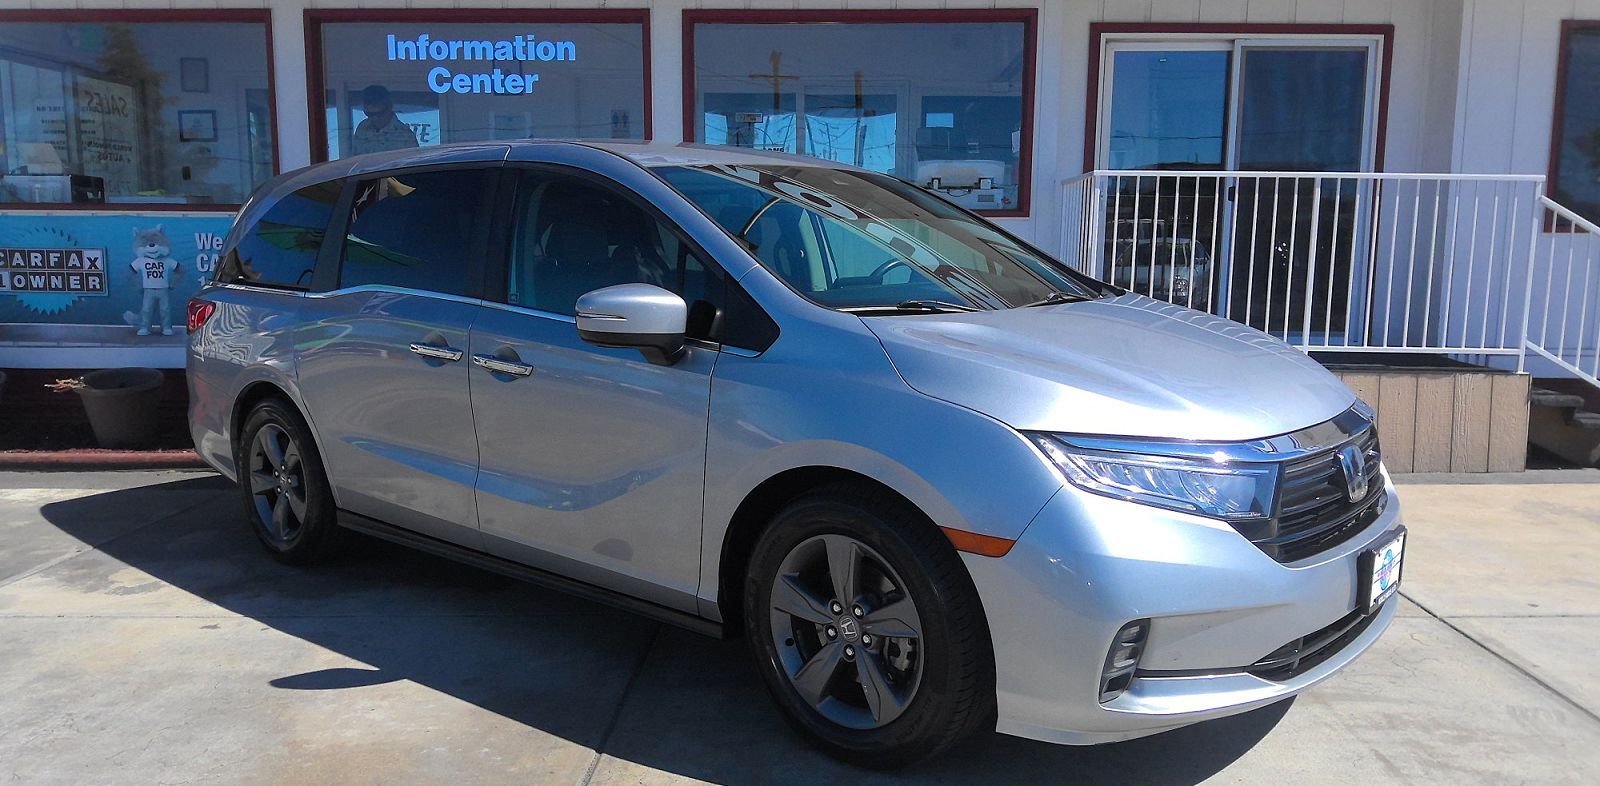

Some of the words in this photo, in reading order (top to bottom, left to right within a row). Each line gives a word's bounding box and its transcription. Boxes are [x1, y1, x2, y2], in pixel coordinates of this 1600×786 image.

[387, 34, 576, 61] Information
[427, 66, 539, 94] Center
[194, 232, 223, 250] We
[144, 262, 164, 270] CAR
[13, 274, 101, 289] OWNER
[146, 270, 164, 279] FOX
